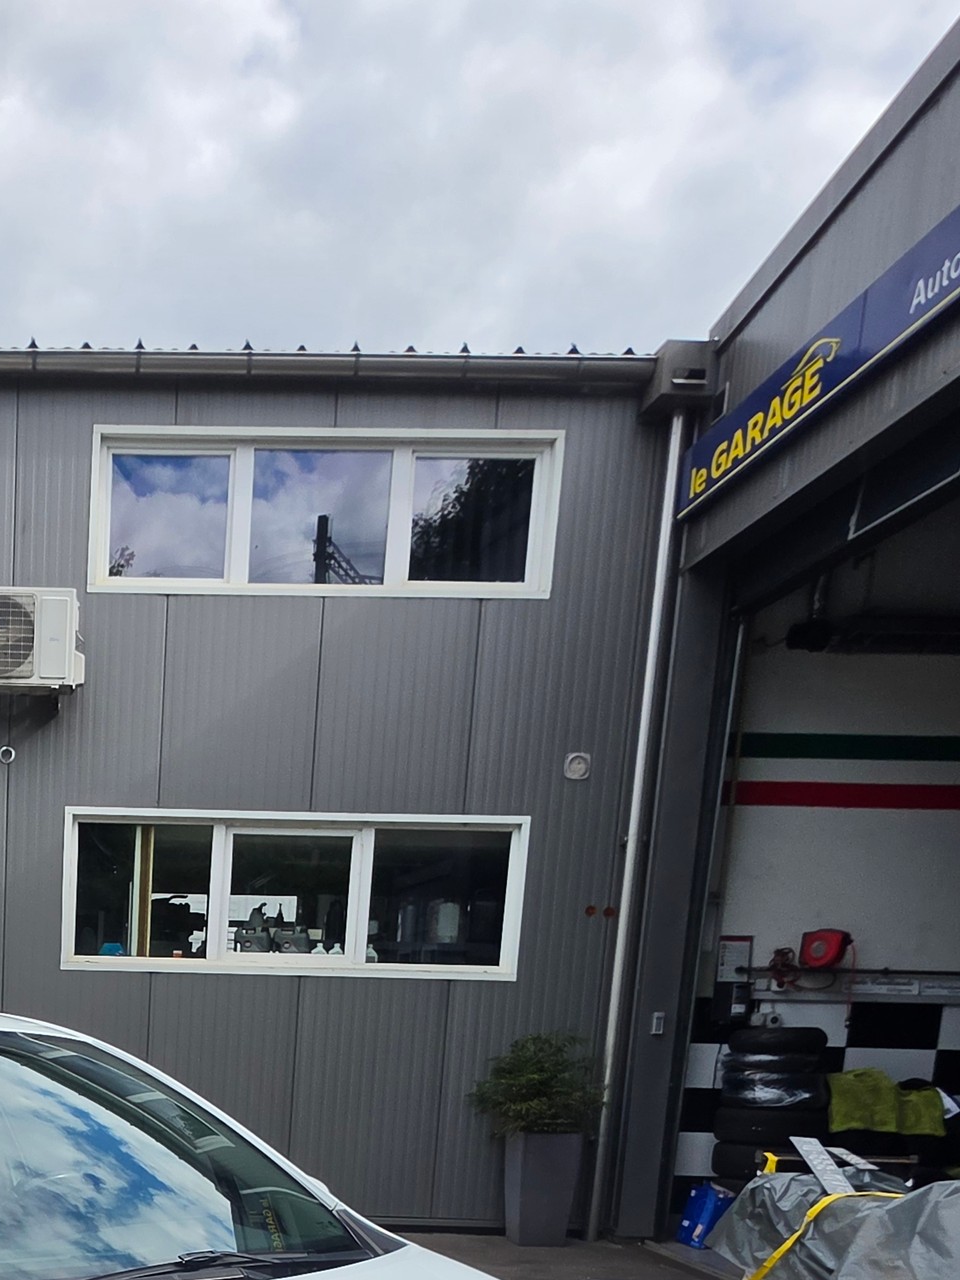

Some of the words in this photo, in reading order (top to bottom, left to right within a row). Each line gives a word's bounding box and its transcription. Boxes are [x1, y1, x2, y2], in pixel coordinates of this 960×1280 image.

[909, 251, 960, 314] Auto
[689, 467, 708, 499] le
[711, 357, 824, 479] GARAGE
